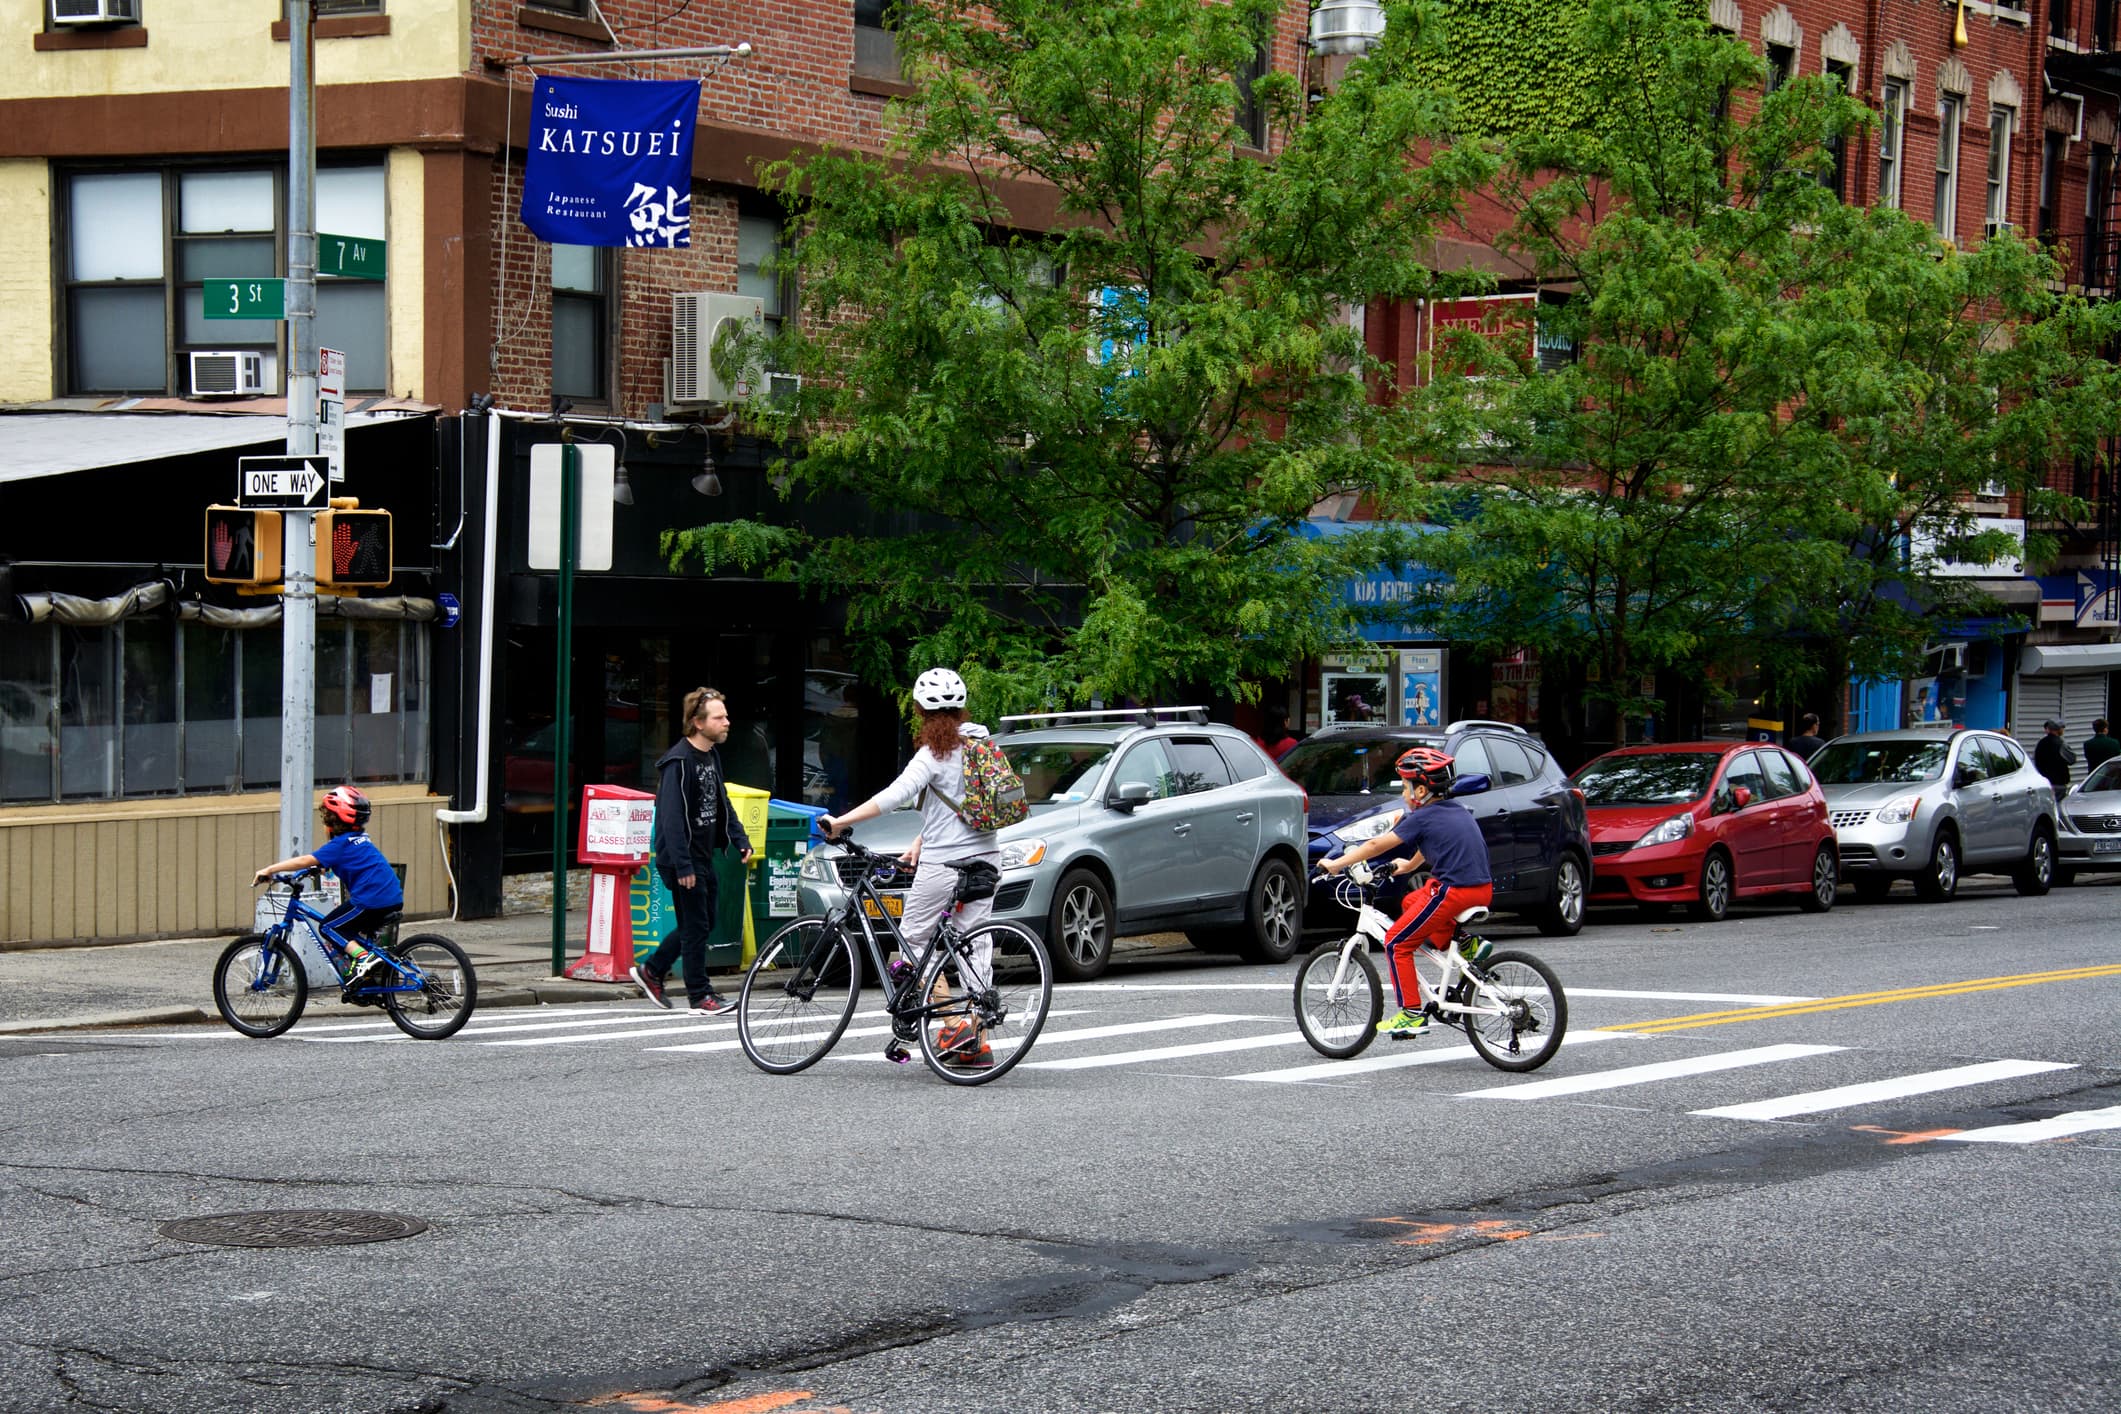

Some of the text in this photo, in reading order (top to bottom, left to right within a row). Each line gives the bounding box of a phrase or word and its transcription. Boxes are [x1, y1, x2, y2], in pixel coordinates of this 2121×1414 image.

[545, 103, 578, 120] Sushi
[548, 192, 596, 205] Japanese
[546, 205, 607, 218] Restaurant
[337, 241, 366, 270] 7 Av
[229, 283, 262, 313] 3 St
[253, 473, 316, 493] ONE WAY
[1354, 581, 1377, 601] KIDS
[1380, 582, 1413, 601] DENTAL
[588, 834, 625, 846] CLASSES
[651, 897, 662, 922] York
